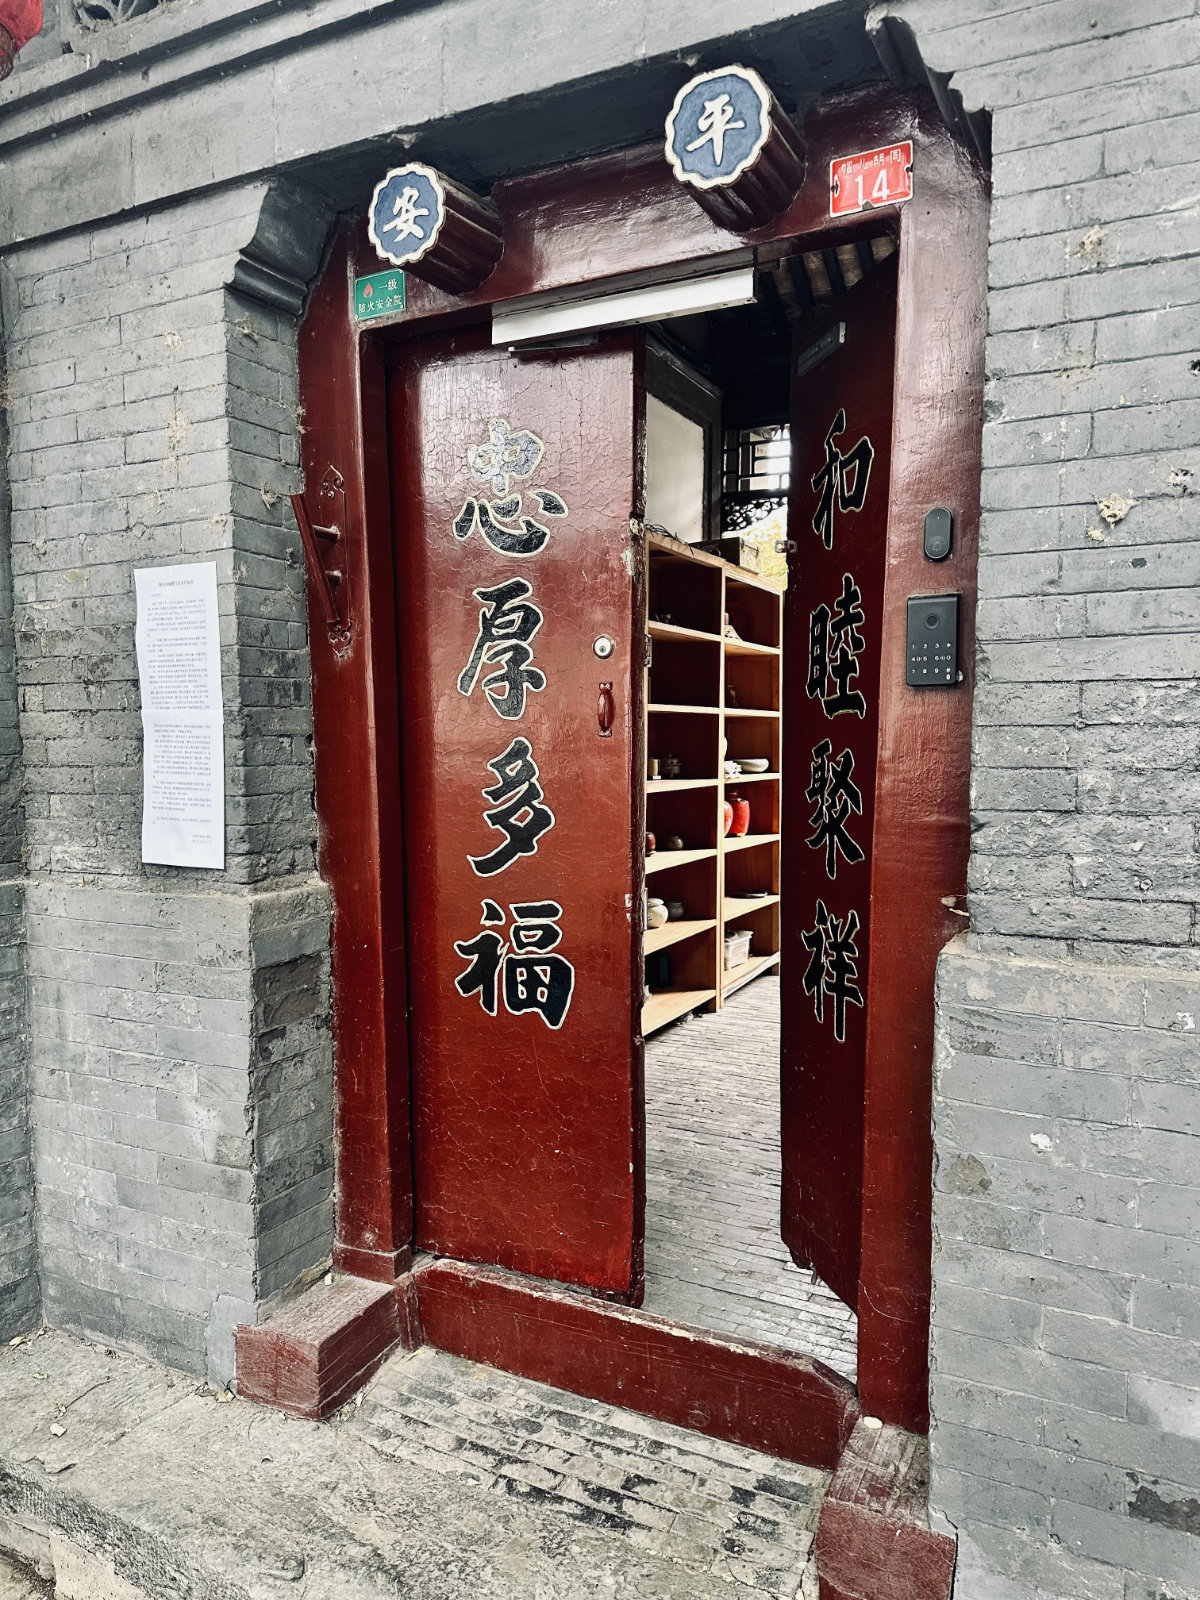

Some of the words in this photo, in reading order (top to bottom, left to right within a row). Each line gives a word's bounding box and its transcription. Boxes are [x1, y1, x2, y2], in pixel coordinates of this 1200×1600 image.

[685, 93, 746, 166] 平
[841, 148, 902, 175] 帽儿胡同
[854, 168, 890, 206] 14
[382, 185, 430, 243] 安
[358, 294, 402, 314] 防火安全院
[378, 278, 398, 291] 一级
[453, 418, 574, 1029] 忠厚多福
[801, 408, 874, 1043] 和睦聚祥
